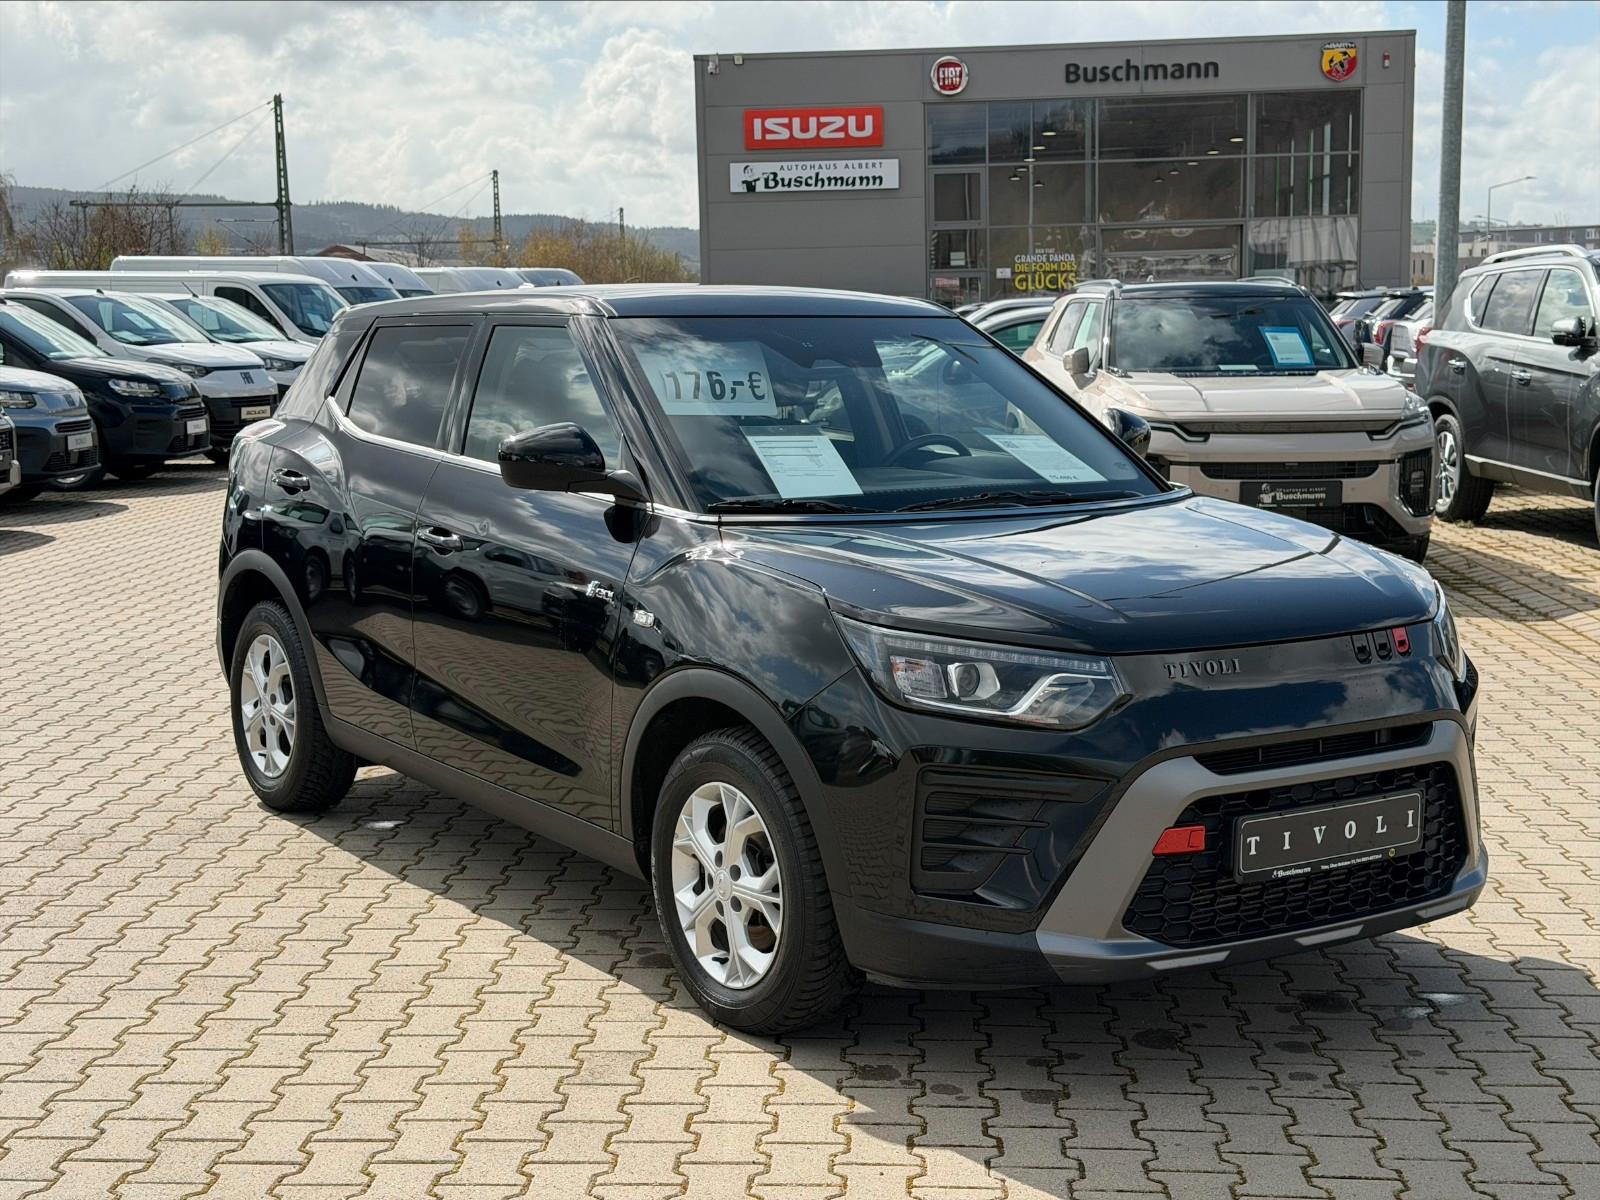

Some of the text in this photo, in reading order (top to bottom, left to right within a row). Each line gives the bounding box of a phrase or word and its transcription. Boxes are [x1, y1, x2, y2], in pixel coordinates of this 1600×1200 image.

[939, 66, 962, 79] FIAT
[1065, 58, 1220, 84] Buschmann
[753, 114, 873, 141] ISUZU
[779, 161, 884, 172] AUTOHAUS ALBERT
[763, 171, 884, 190] Buschmann
[1014, 253, 1076, 263] GRANDE PANDA
[1014, 262, 1077, 273] DIE FORM DES
[1014, 271, 1078, 291] GLÜCKS
[1164, 658, 1241, 679] TIVOLI
